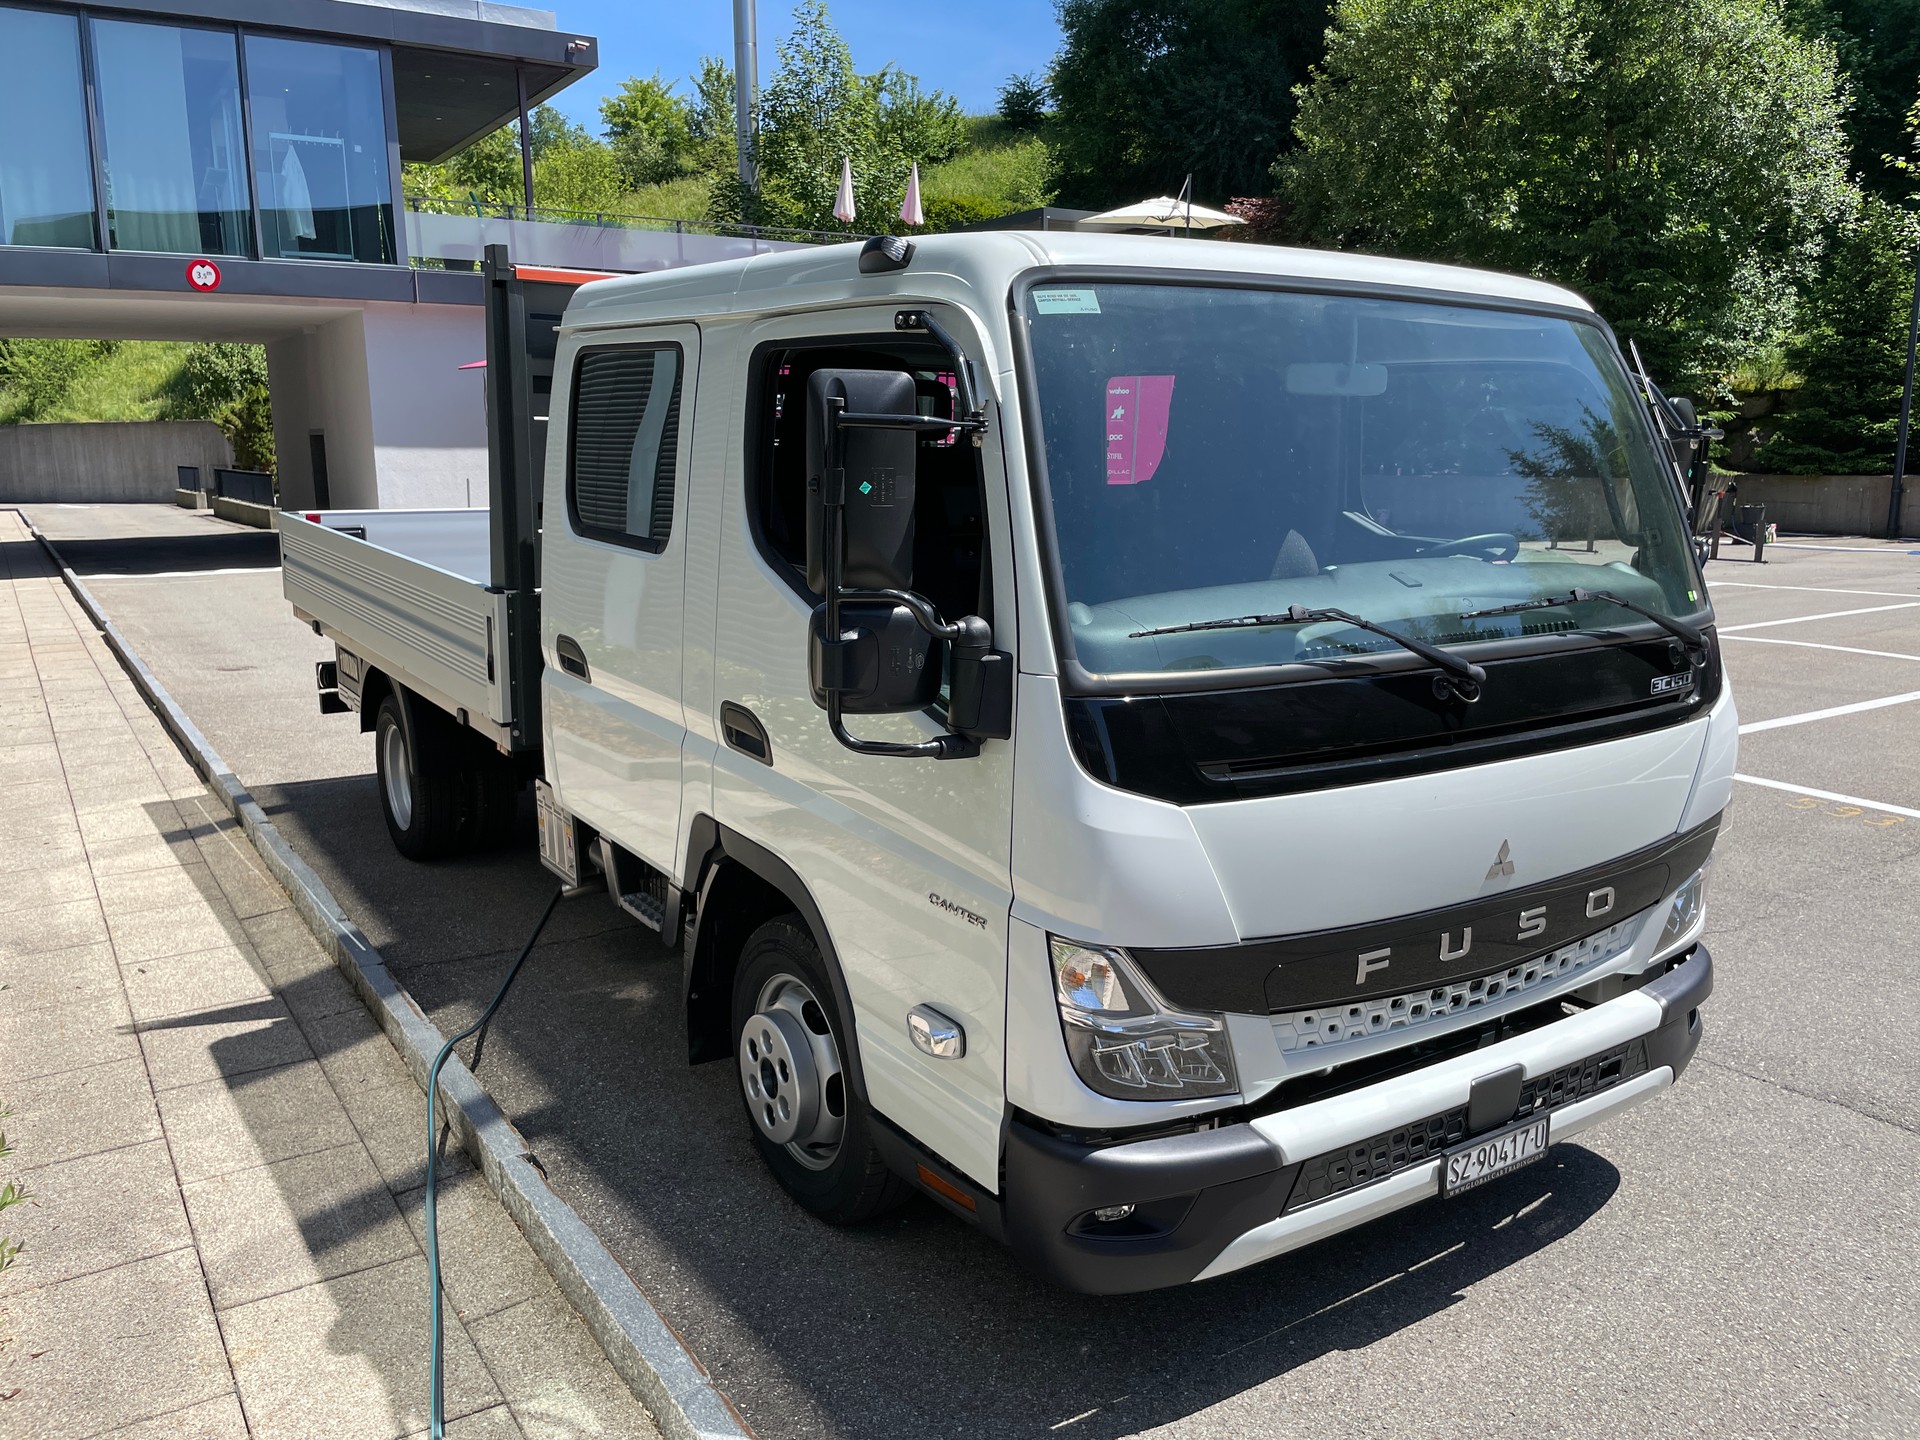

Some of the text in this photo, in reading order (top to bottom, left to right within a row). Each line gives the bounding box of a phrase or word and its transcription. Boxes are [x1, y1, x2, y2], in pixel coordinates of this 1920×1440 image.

[1109, 386, 1130, 394] wahoo
[929, 892, 987, 930] CANTER
[1356, 886, 1615, 985] FUSO
